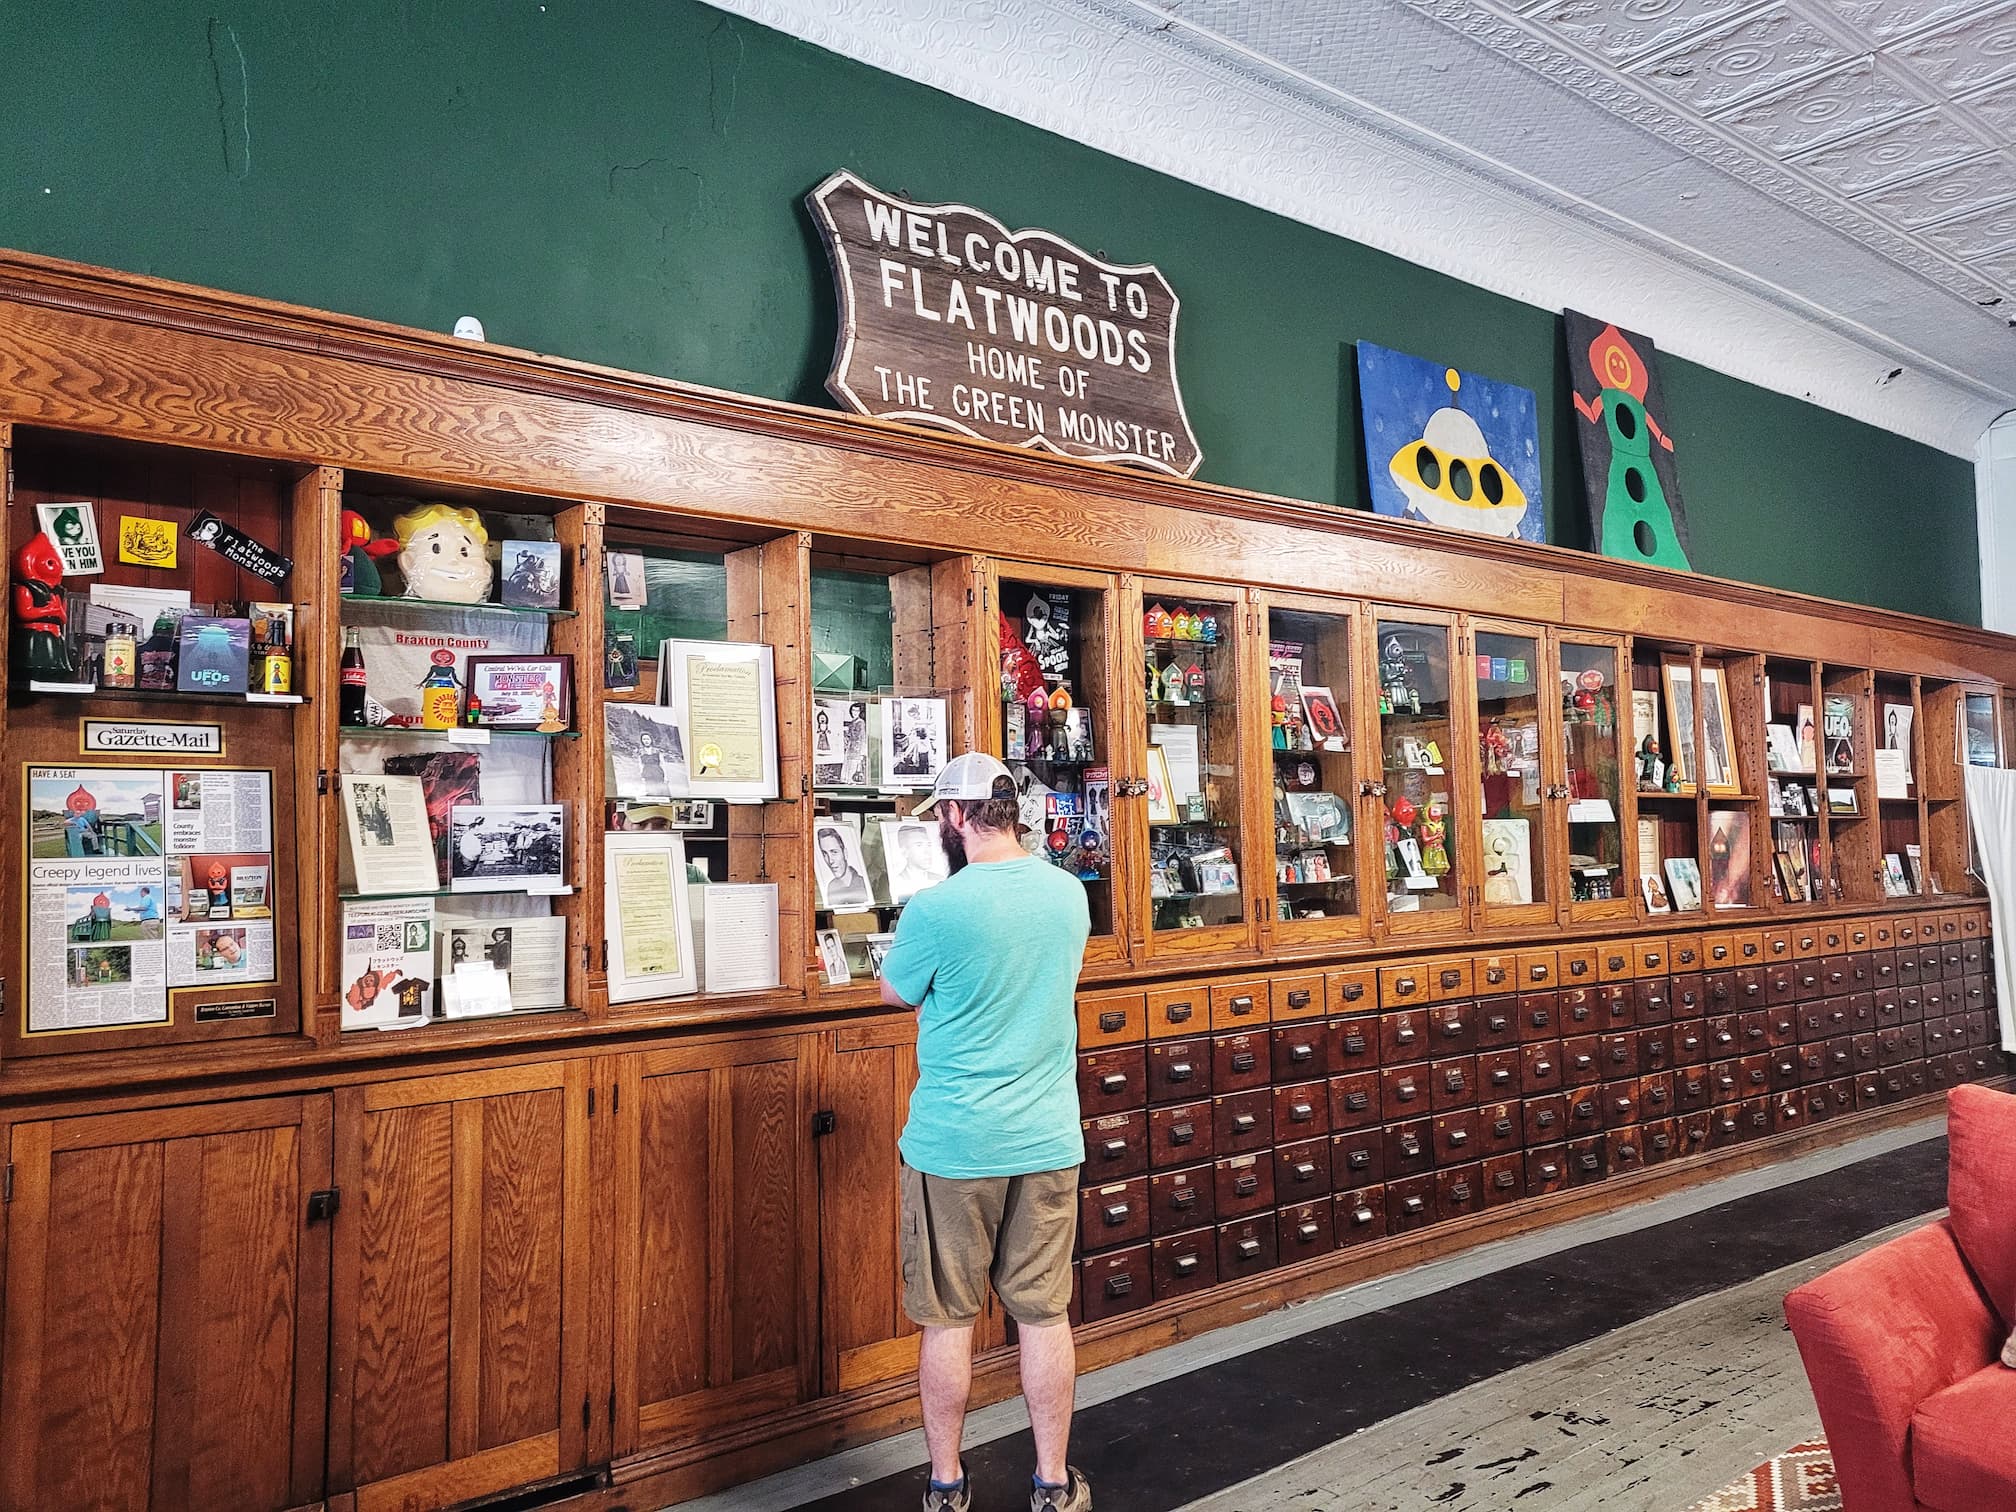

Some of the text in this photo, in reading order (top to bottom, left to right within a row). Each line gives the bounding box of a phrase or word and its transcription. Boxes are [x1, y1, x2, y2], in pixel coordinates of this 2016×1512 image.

[863, 198, 1149, 320] WELCOME TO
[880, 258, 1152, 374] FLATWOODS
[967, 342, 1090, 400] HOME OF
[874, 366, 1176, 462] THE GREEN MONSTER
[62, 546, 96, 558] VE YOU
[247, 540, 264, 554] The
[80, 558, 98, 569] HIM
[223, 535, 286, 578] Flatwoods
[225, 547, 272, 577] Monster
[1048, 593, 1069, 601] FRIDAY
[395, 634, 489, 649] Braxton County
[1038, 650, 1070, 671] SPOOK
[191, 670, 231, 683] UFOs
[112, 727, 148, 735] Saturday
[97, 730, 209, 748] Gazette-Mail
[32, 770, 50, 778] HAVE
[60, 771, 75, 779] SEAT
[173, 823, 194, 831] County
[33, 864, 162, 880] Creepy legend lives
